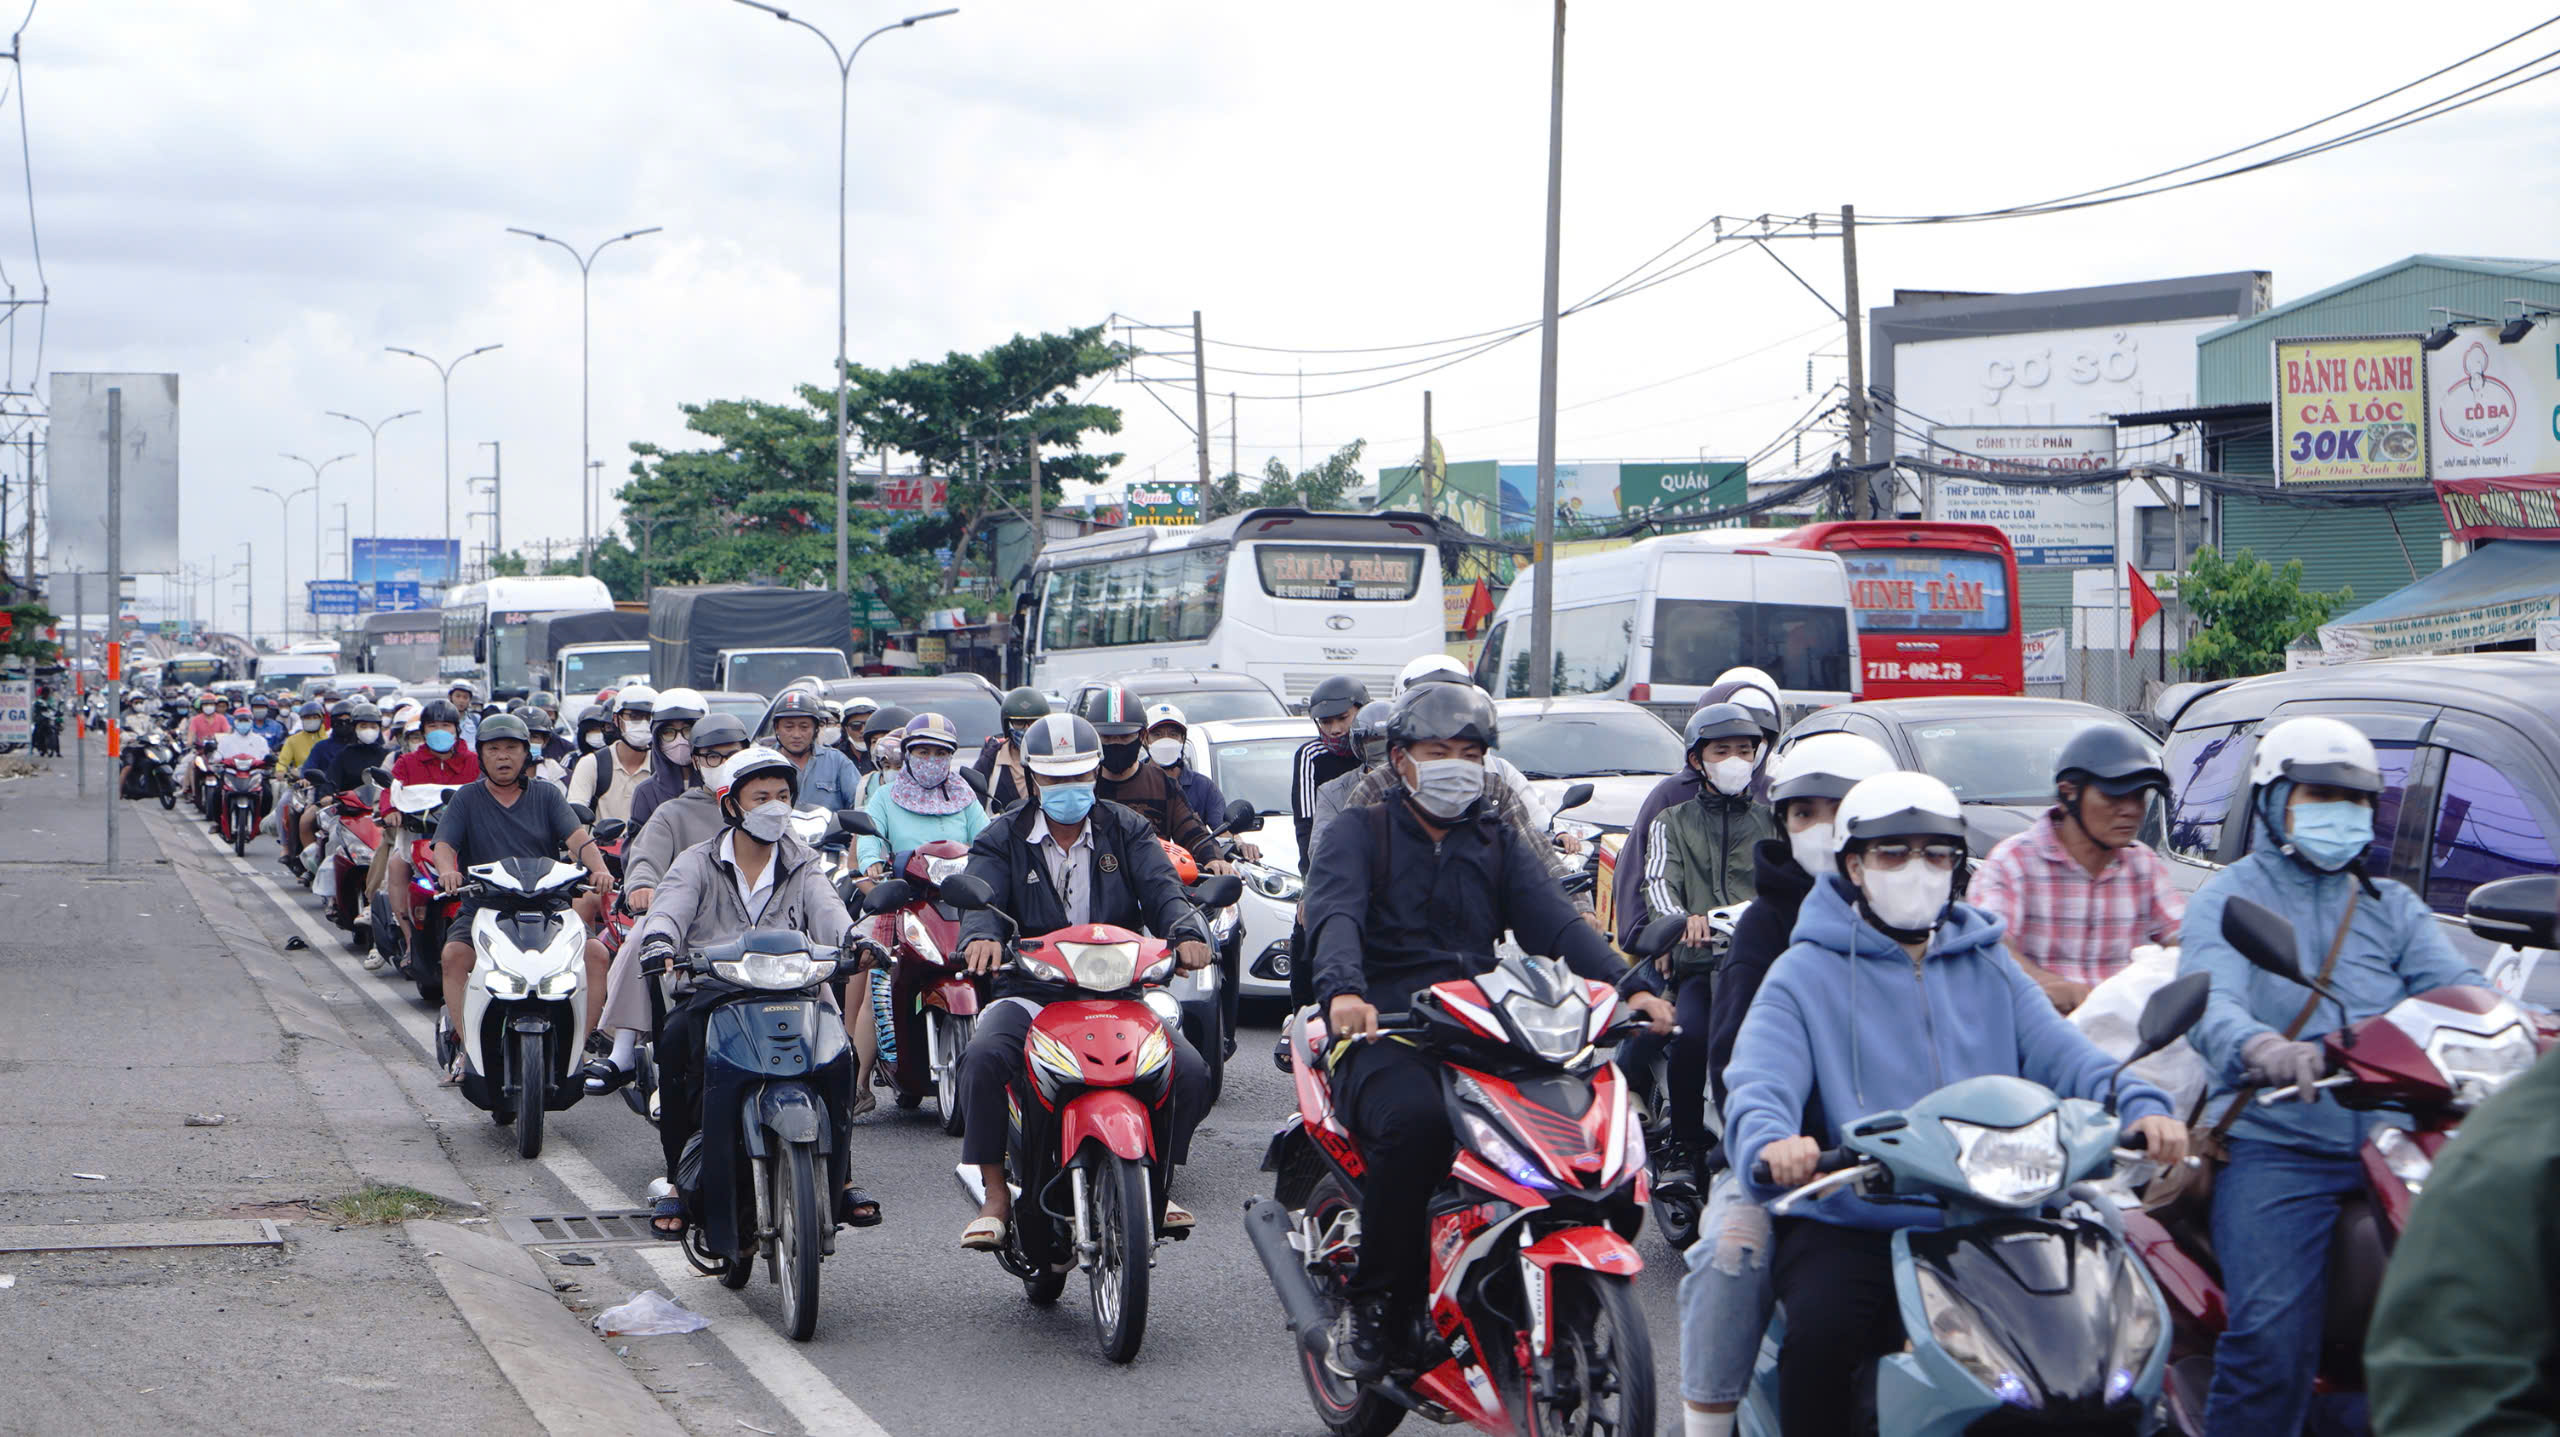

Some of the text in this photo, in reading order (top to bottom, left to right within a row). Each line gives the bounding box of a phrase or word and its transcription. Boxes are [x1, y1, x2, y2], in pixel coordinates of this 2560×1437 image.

[2287, 349, 2414, 394] BÁNH CANH
[2300, 396, 2404, 425] CÁ LÓC
[2465, 402, 2510, 420] CÔ BA
[2290, 429, 2363, 462] 30K
[1660, 470, 1710, 492] QUÁN
[1848, 572, 1985, 611] MINH TÂM
